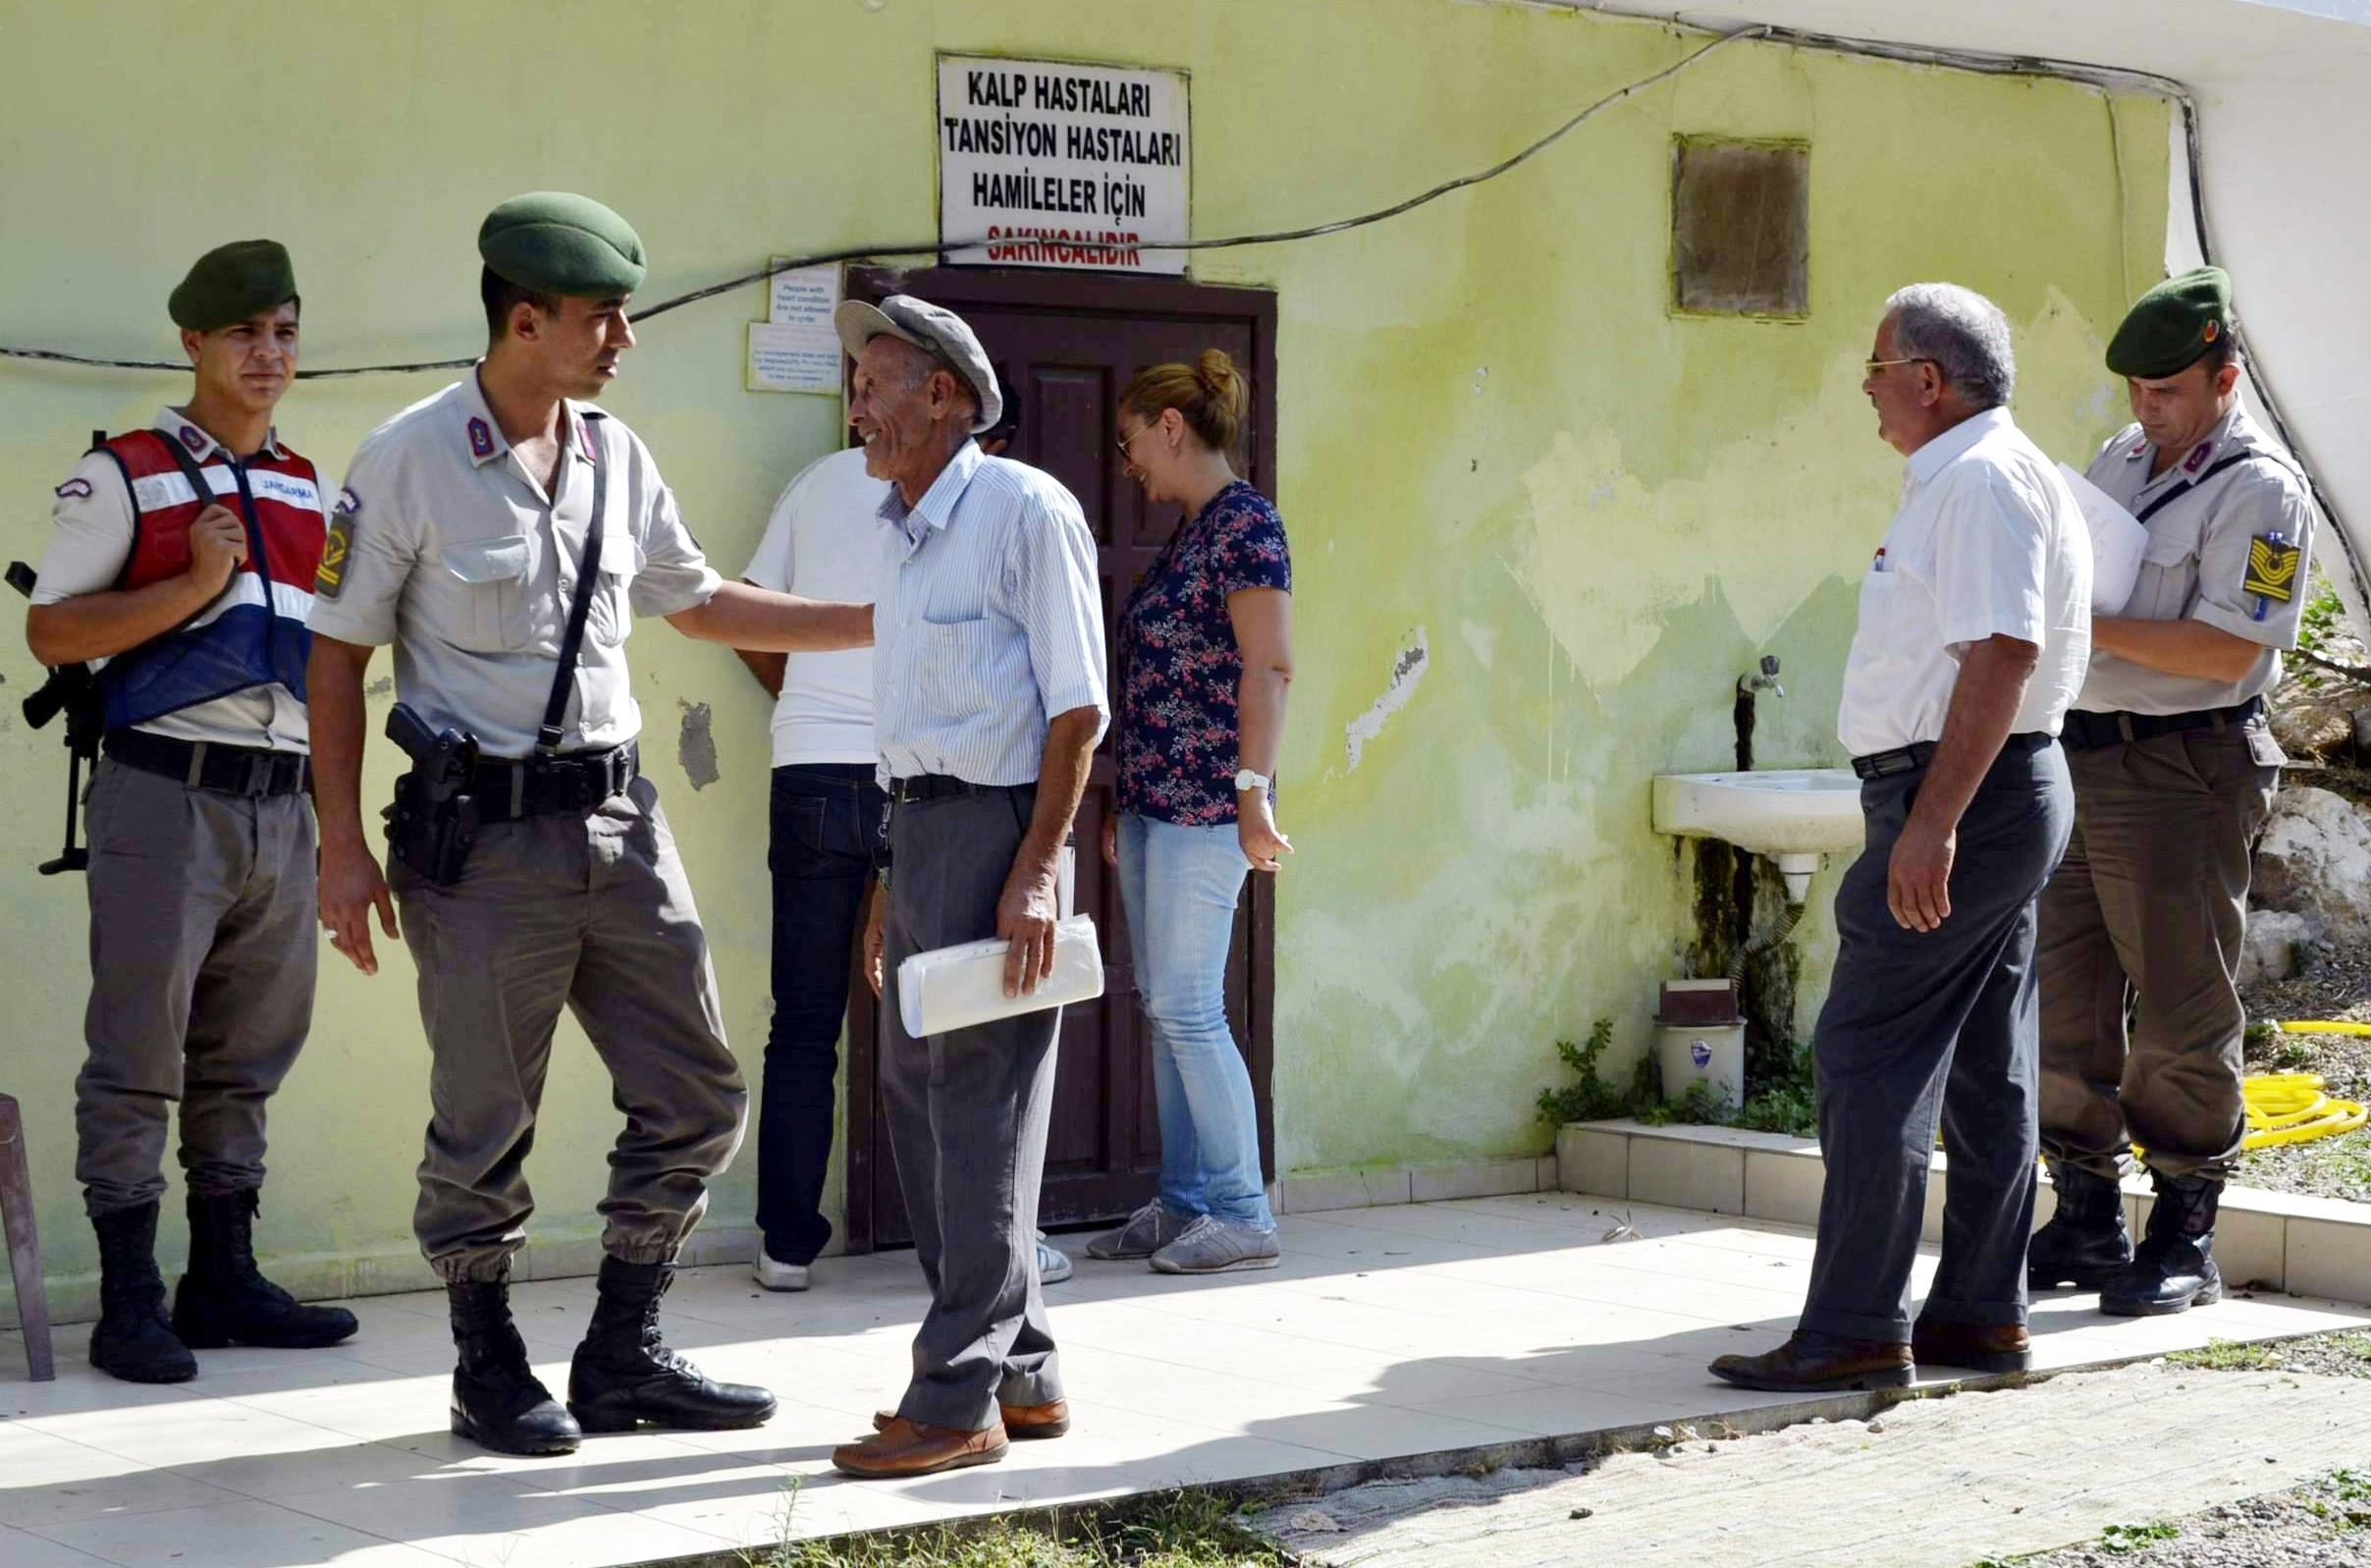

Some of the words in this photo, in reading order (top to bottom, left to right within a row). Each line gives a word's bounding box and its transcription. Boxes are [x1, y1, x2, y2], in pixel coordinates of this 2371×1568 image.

[968, 71, 1027, 108] KALP
[1034, 76, 1151, 117] HASTALARI
[943, 113, 1056, 157] TANSİYON
[1067, 126, 1181, 166] HASTALARI
[973, 167, 1097, 214] HAMİLELER
[1104, 172, 1146, 226] İÇİN
[988, 226, 1140, 266] SAKINCALIDIR
